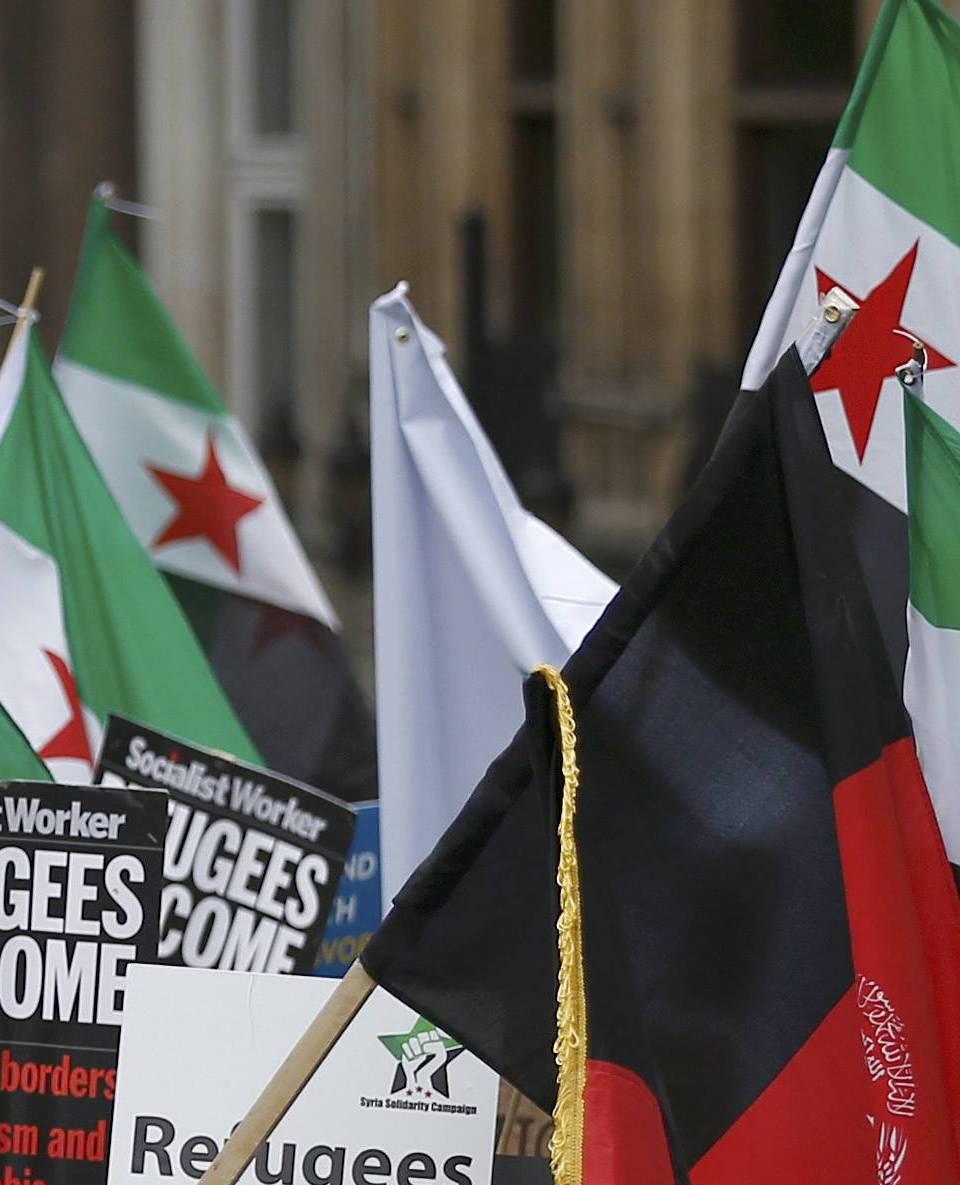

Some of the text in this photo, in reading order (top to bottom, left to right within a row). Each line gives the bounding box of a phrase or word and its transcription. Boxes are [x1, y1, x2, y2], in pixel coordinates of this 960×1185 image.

[165, 801, 330, 930] UGEES
[0, 1049, 116, 1099] borders
[360, 1097, 477, 1115] Syria Solidarity Campaign
[48, 1120, 106, 1162] and
